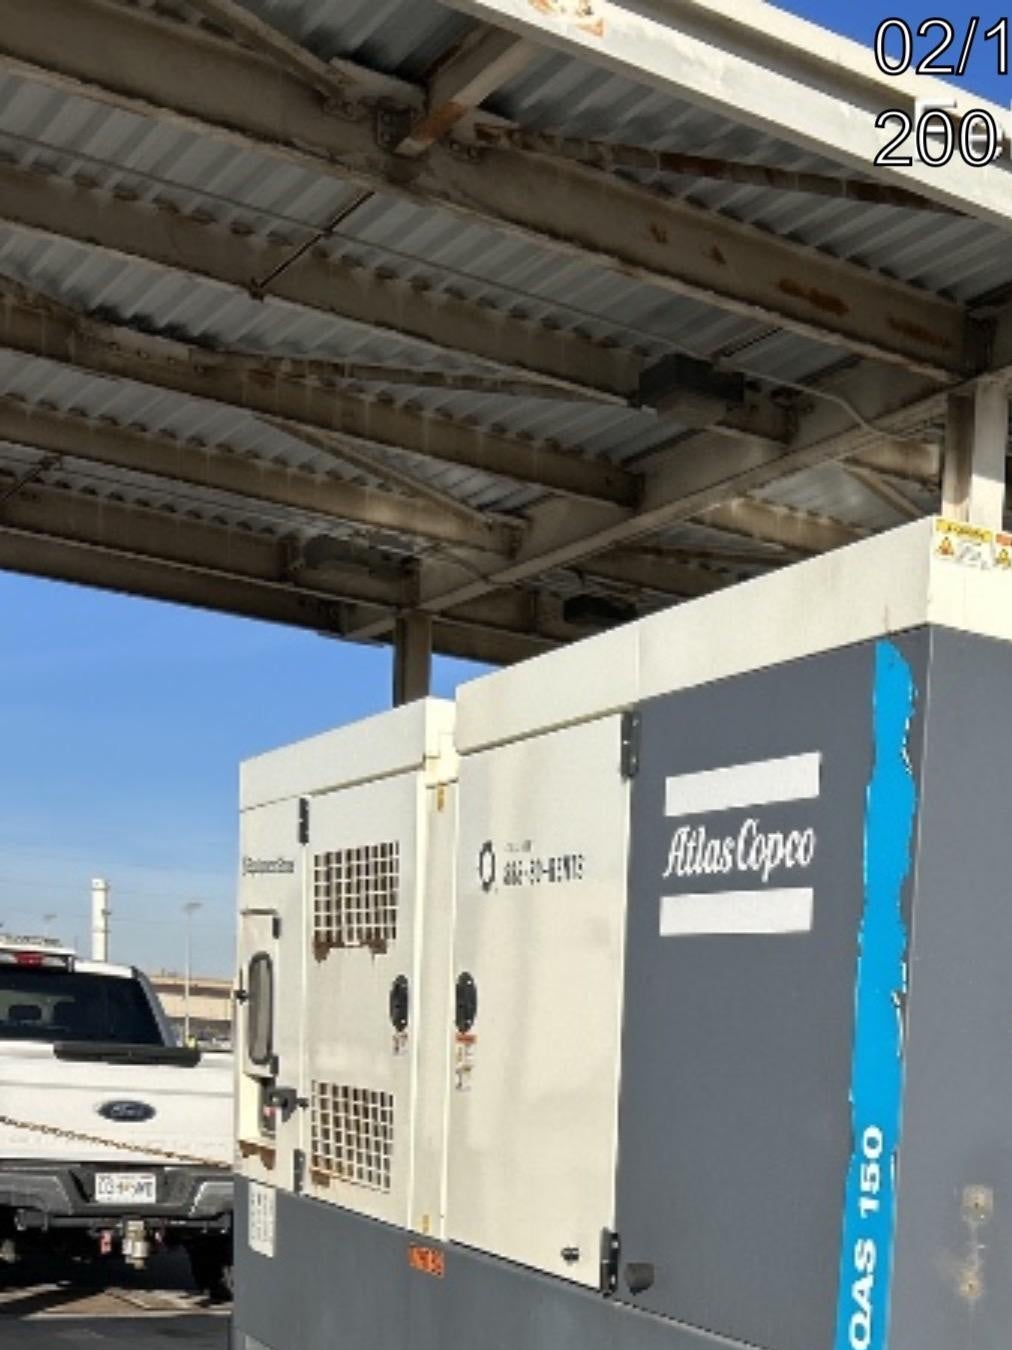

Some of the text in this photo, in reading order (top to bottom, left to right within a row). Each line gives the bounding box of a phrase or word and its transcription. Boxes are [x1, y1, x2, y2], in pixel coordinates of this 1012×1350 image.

[662, 818, 816, 883] Atlas Copco
[858, 1124, 883, 1219] 150
